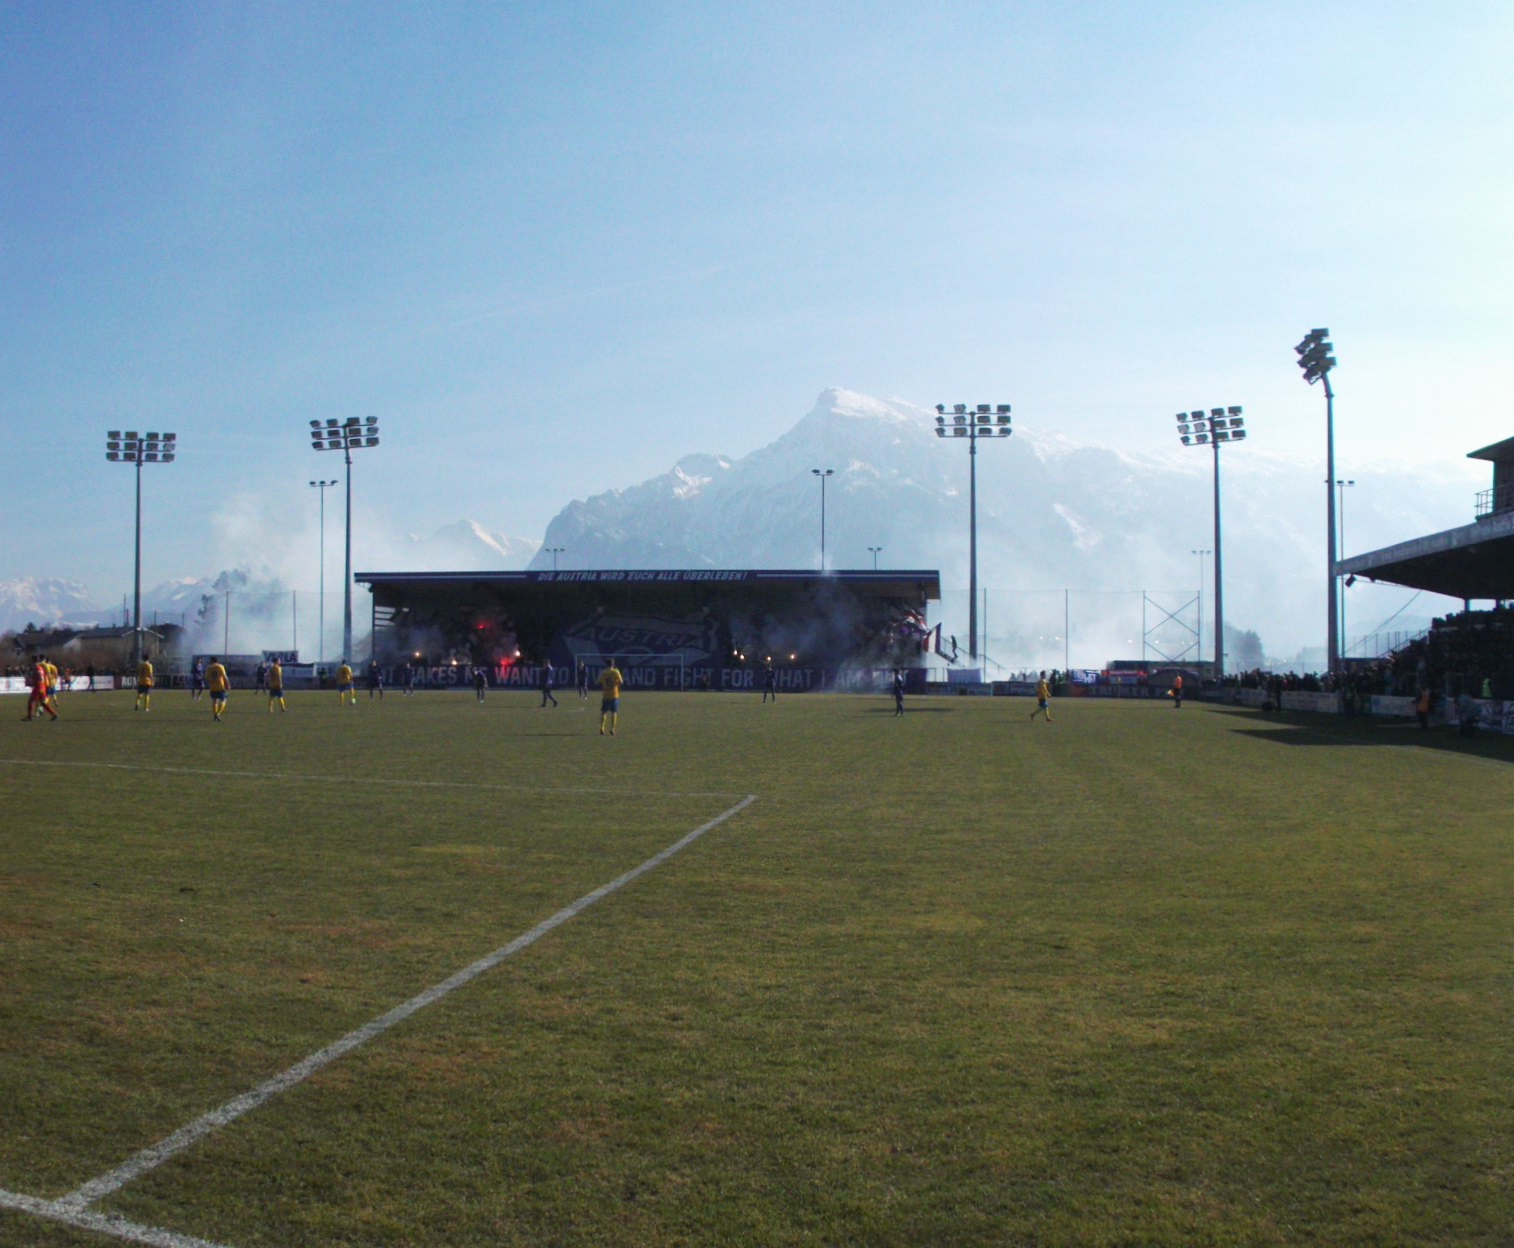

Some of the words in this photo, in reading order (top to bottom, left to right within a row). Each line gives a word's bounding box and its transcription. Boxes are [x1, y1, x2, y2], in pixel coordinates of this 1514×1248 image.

[538, 572, 553, 581] DIE
[556, 572, 597, 581] AUSTRIA
[600, 572, 624, 581] WIRD
[627, 571, 654, 581] EUCH
[657, 571, 680, 581] ALLE
[575, 627, 704, 648] AUSTRIA
[494, 667, 543, 685] WANT
[622, 667, 656, 686] AND
[664, 668, 715, 687] FIGHT
[721, 668, 755, 687] FOR
